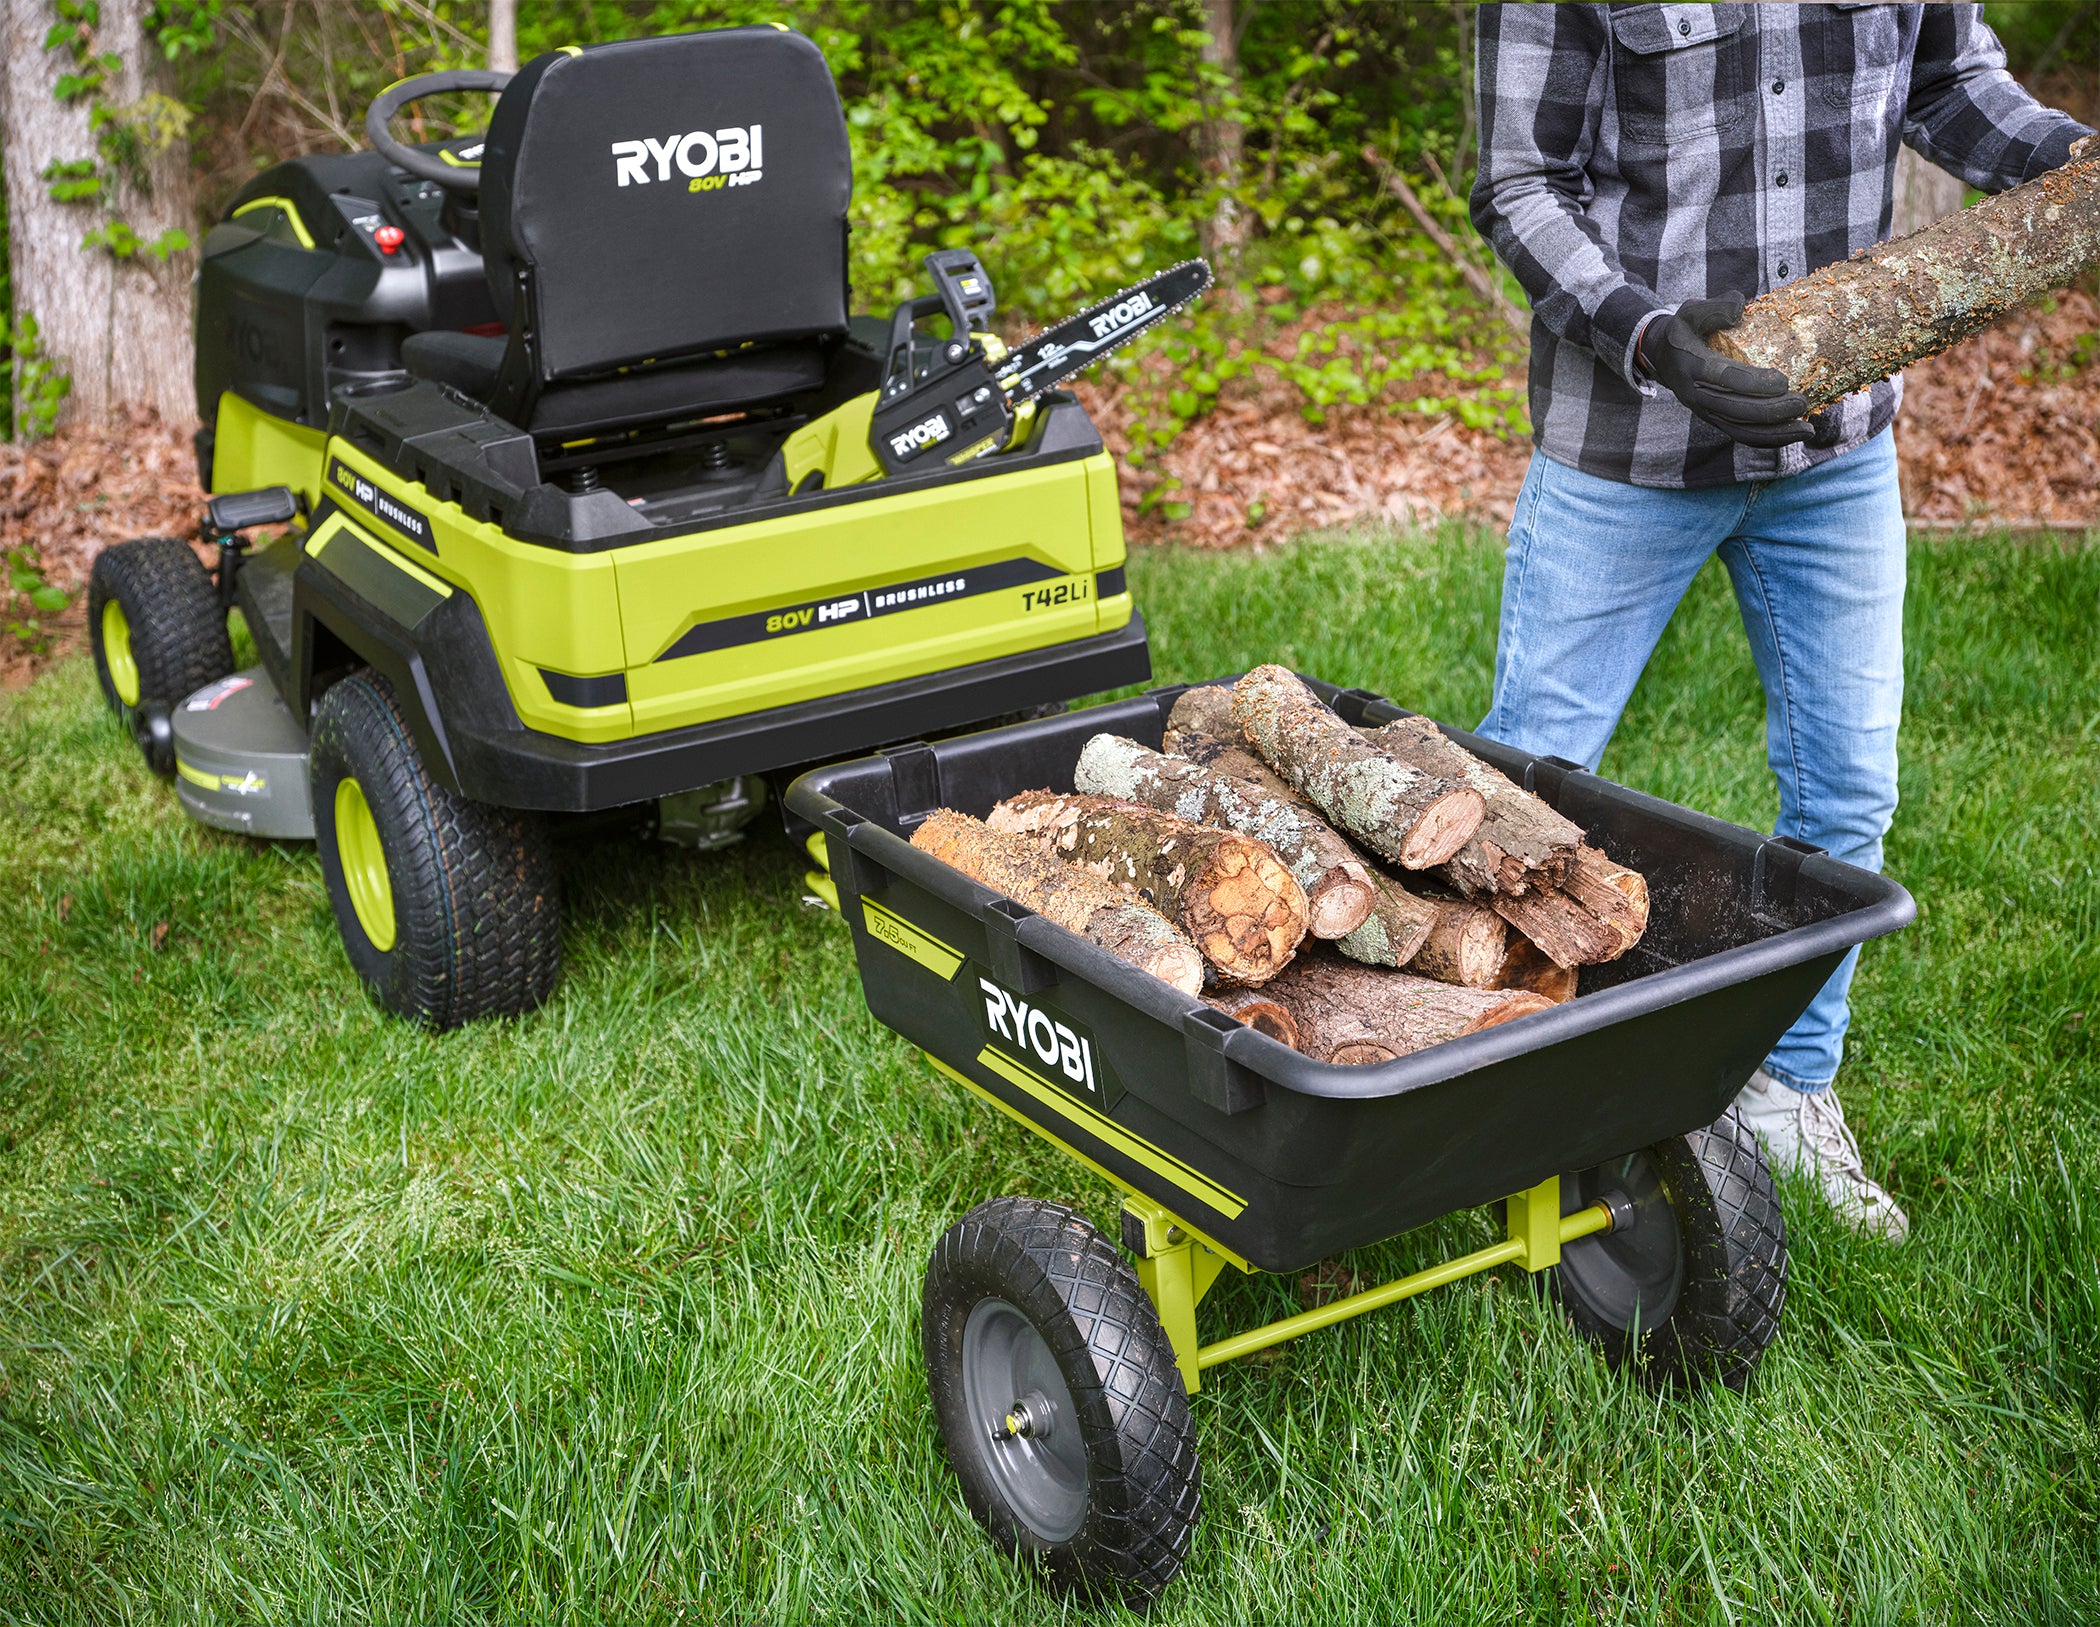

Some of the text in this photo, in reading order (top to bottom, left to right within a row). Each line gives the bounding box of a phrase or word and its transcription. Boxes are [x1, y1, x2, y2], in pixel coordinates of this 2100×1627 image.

[612, 124, 763, 187] RYOBI
[688, 170, 763, 193] 80V HP
[1088, 290, 1154, 338] RYOBI
[1037, 342, 1056, 360] 12
[889, 414, 949, 456] RYOBI
[336, 465, 423, 535] 80V HP BRUSHLESS
[765, 578, 967, 633] 80V HP BRUSHLESS
[1022, 579, 1088, 612] T42Li
[873, 915, 900, 944] 7.5
[979, 976, 1096, 1093] RYOBI
